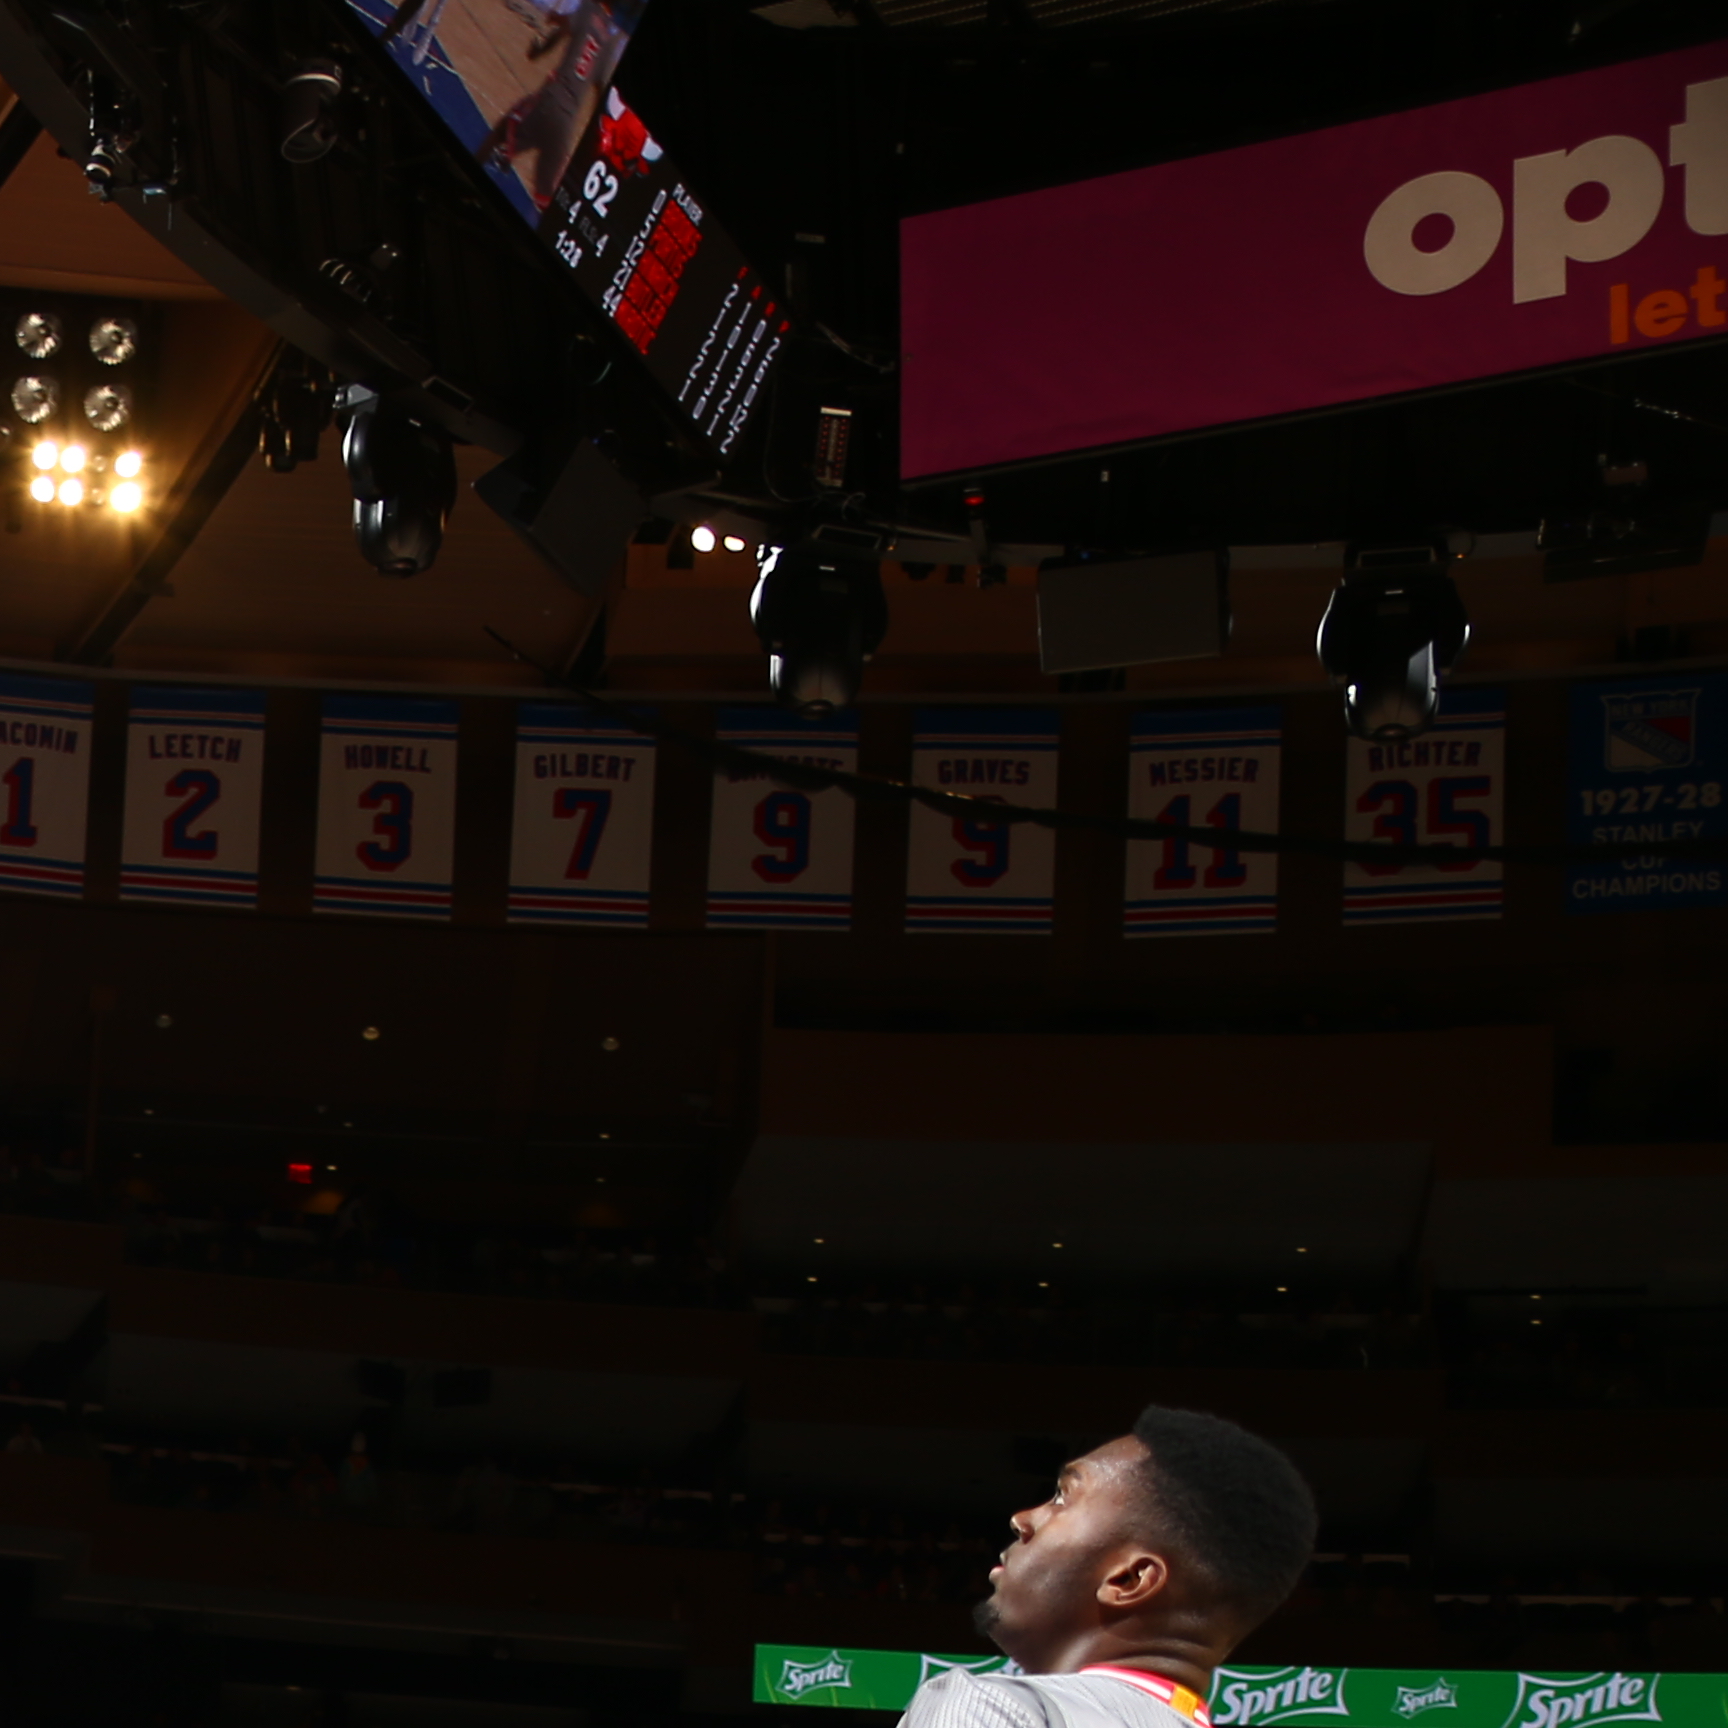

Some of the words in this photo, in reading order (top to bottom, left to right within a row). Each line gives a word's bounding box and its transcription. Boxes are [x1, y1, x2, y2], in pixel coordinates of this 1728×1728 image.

[582, 160, 619, 219] 62
[1363, 76, 1728, 305] opt
[625, 235, 645, 266] 12
[701, 331, 716, 356] 2
[715, 349, 728, 372] 1
[729, 366, 744, 390] 3
[639, 213, 656, 239] 5
[713, 308, 726, 331] 1
[1610, 266, 1727, 345] let
[613, 259, 632, 291] 21
[689, 354, 704, 379] 2
[704, 372, 718, 396] 3
[717, 389, 732, 414] 2
[729, 404, 747, 433] 12
[723, 283, 739, 308] 2
[738, 302, 751, 325] 1
[765, 337, 780, 361] 2
[602, 285, 623, 317] 44
[678, 379, 691, 402] 1
[706, 413, 719, 436] 1
[720, 430, 735, 454] 2
[148, 734, 242, 763] LEETCH
[344, 745, 432, 774] HOWELL
[534, 753, 636, 782] GILBERT
[938, 759, 1031, 786] GRAVES
[1149, 757, 1259, 787] MESSIER
[1368, 741, 1482, 772] RICHTER
[0, 757, 37, 848] 1
[162, 769, 221, 860] 2
[356, 780, 413, 872] 3
[552, 788, 612, 880] 7
[752, 791, 811, 883] 9
[951, 794, 1010, 888] 9
[1154, 793, 1247, 890] 11
[1356, 775, 1491, 878] 35
[1581, 781, 1723, 817] 1927-28
[1592, 820, 1705, 845] STANLEY
[1572, 871, 1722, 900] CHAMPIONS
[784, 1659, 845, 1691] Sprite
[1214, 1667, 1333, 1726] Sprite
[1398, 1686, 1449, 1713] Sprite
